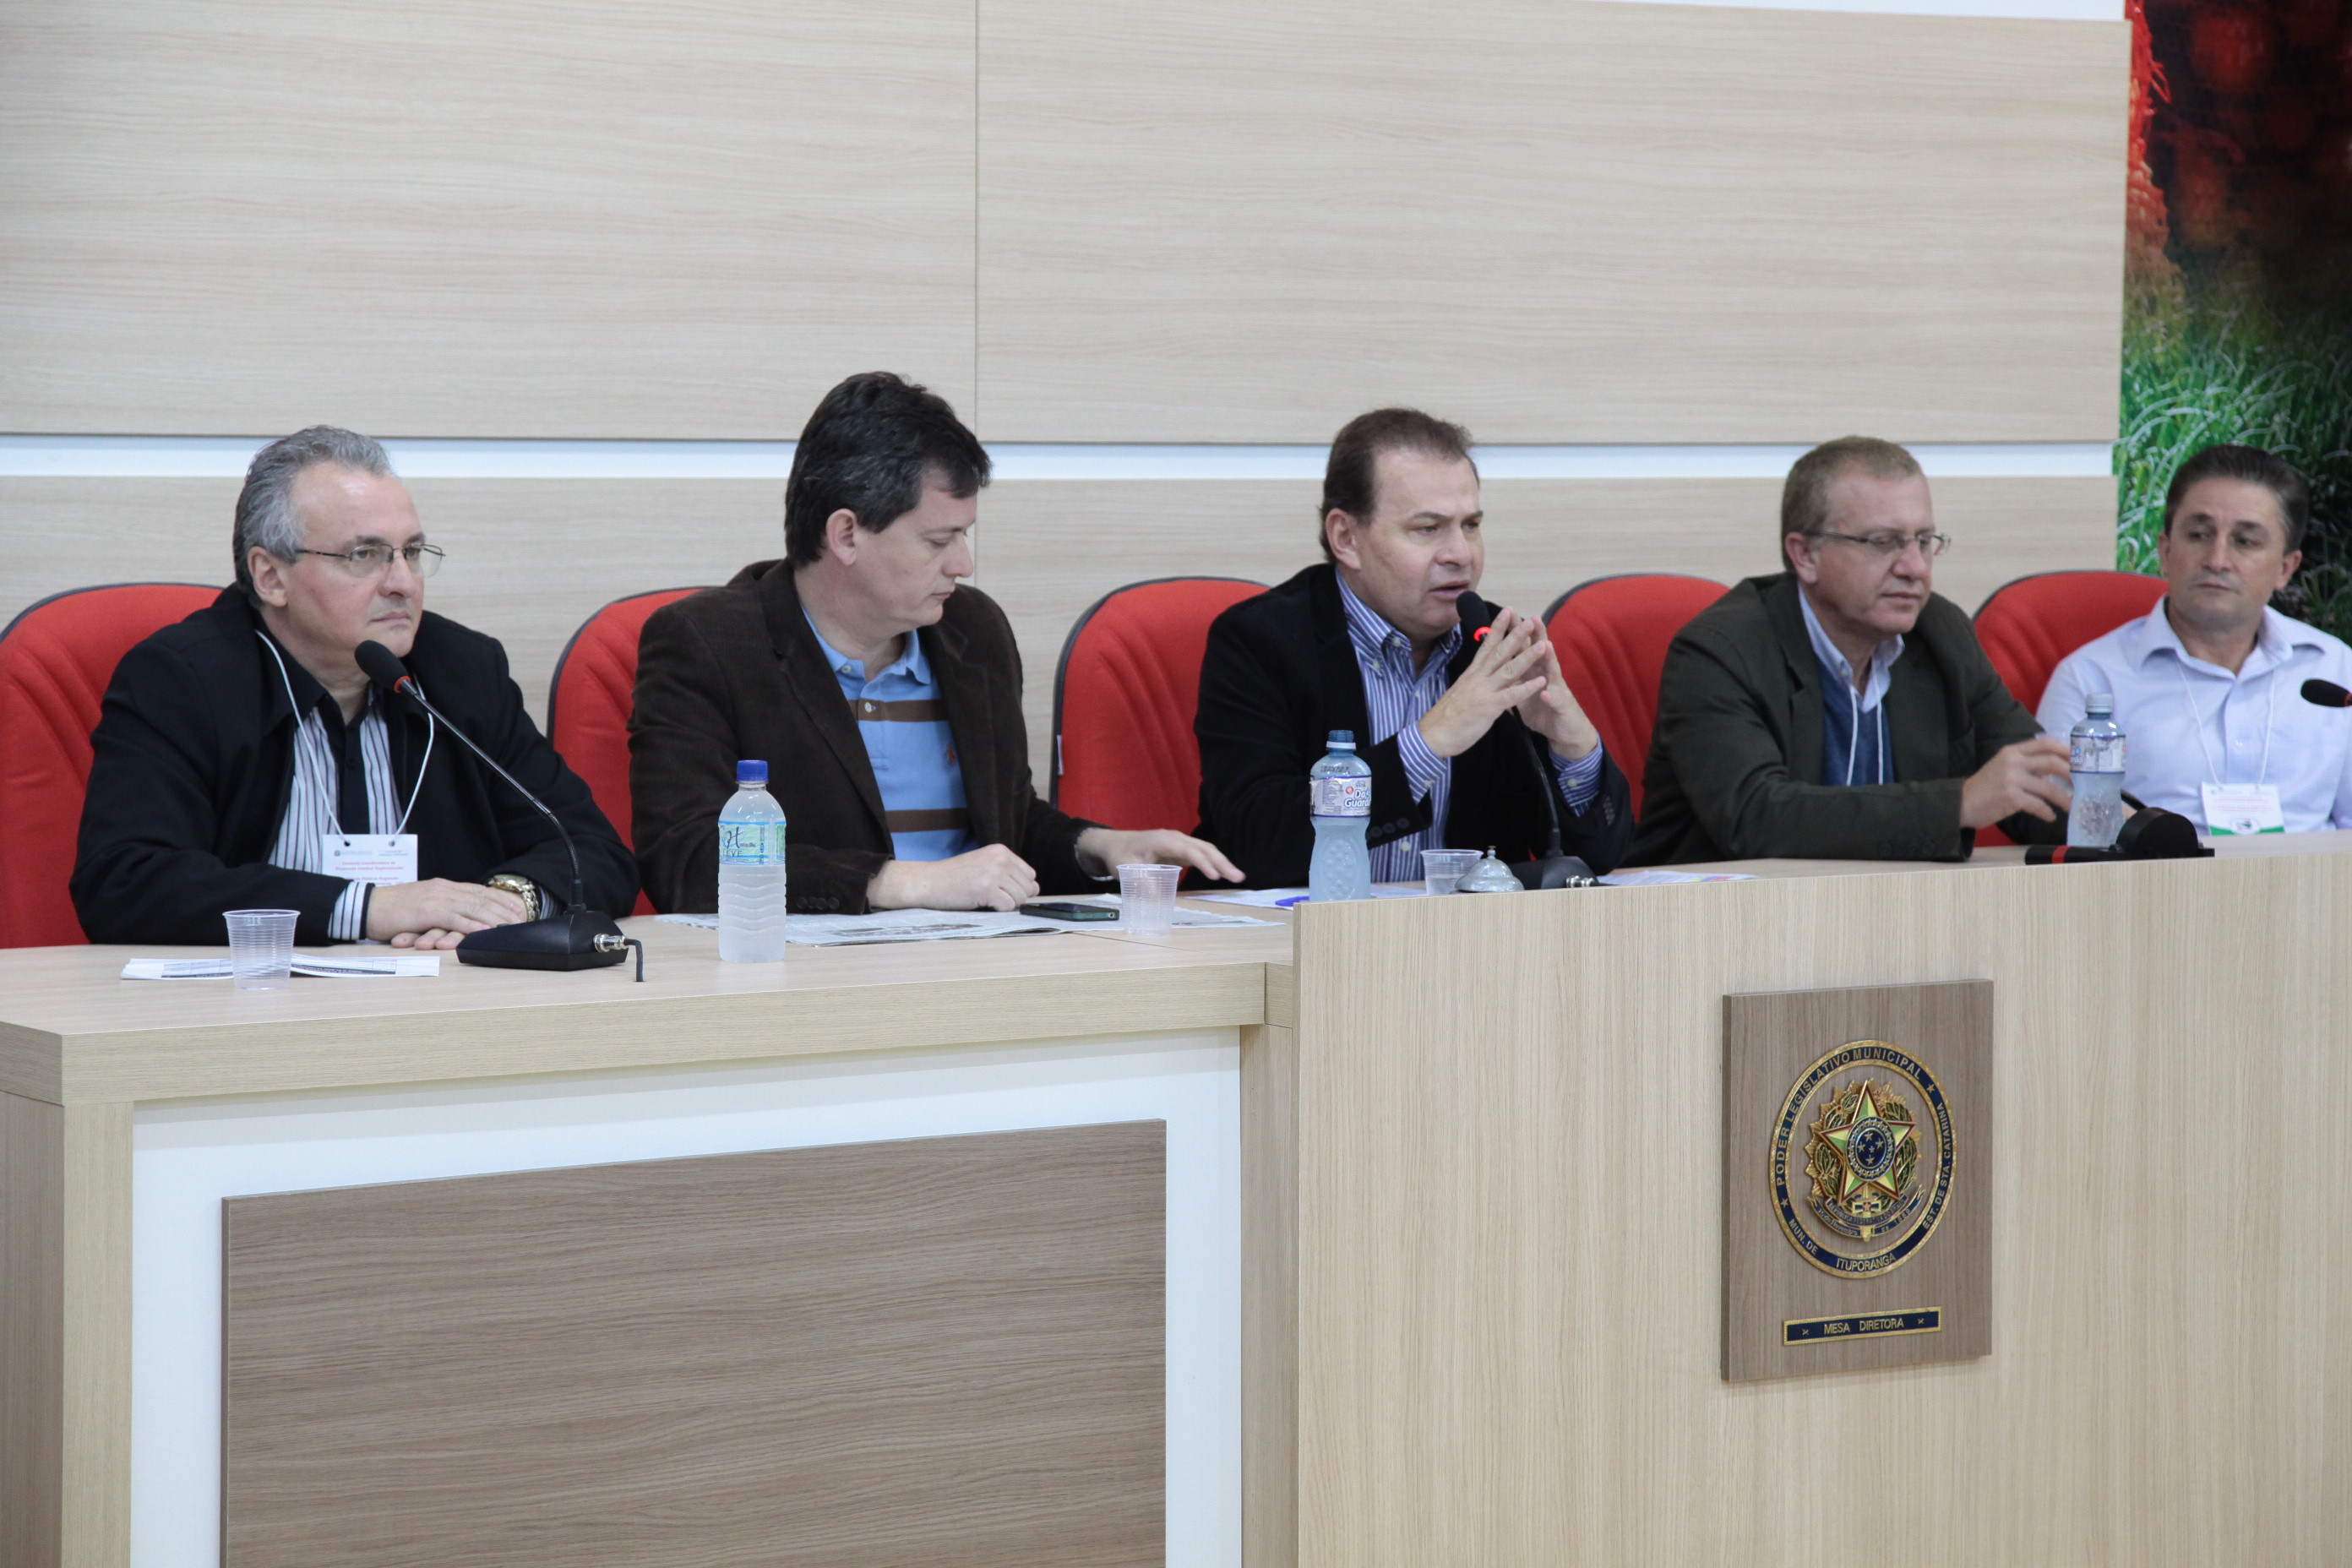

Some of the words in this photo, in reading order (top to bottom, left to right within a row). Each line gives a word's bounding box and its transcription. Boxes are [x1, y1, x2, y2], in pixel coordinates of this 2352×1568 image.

[722, 849, 743, 858] LEVE
[1776, 1127, 1790, 1186] PODER
[1785, 1053, 1850, 1122] LEGISLATIVO
[1853, 1048, 1921, 1081] MUNICIPAL
[1936, 1102, 1951, 1158] CATARINA
[1934, 1189, 1945, 1206] DE
[1922, 1207, 1939, 1229] EST.
[1788, 1217, 1805, 1244] MUN.
[1805, 1240, 1818, 1255] DE
[1836, 1253, 1897, 1272] ITUPORANGA
[1823, 1322, 1851, 1335] MESA
[1859, 1317, 1904, 1331] DIRETORA
